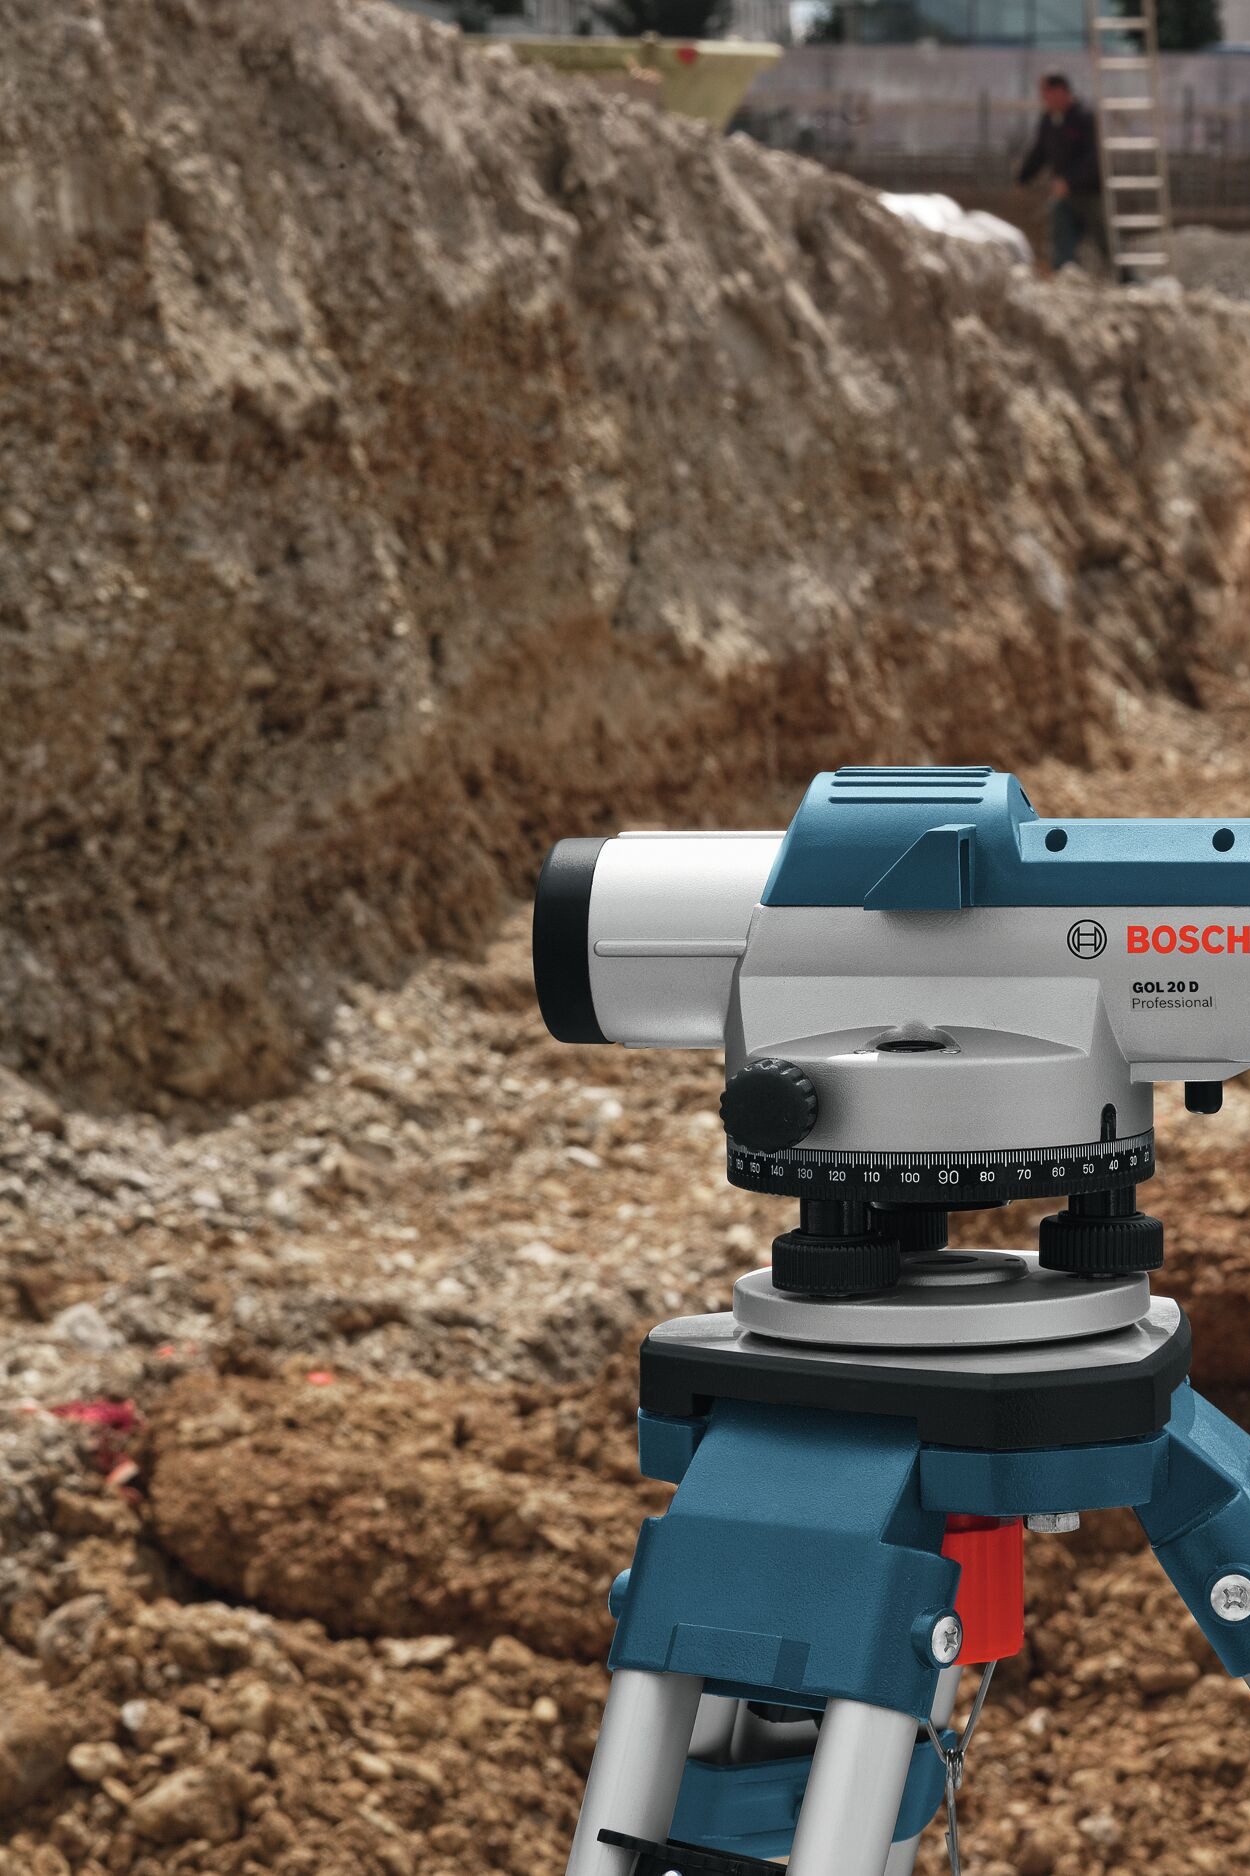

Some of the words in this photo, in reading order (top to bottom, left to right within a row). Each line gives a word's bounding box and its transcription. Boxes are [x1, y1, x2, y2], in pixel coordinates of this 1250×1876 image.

[1127, 925, 1250, 954] BOSCH
[1132, 981, 1164, 993] GOL
[1167, 981, 1186, 993] 20
[1189, 981, 1199, 993] D
[1132, 996, 1213, 1009] Professional
[750, 1162, 761, 1174] 150
[771, 1165, 784, 1177] 140
[797, 1168, 813, 1180] 130
[828, 1170, 846, 1182] 120
[863, 1171, 880, 1182] 110
[900, 1172, 920, 1183] 100
[938, 1170, 959, 1184] 90
[979, 1171, 995, 1182] 80
[1017, 1168, 1032, 1180] 70
[1051, 1166, 1066, 1178] 60
[1083, 1163, 1095, 1175] 50
[1109, 1159, 1119, 1170] 40
[1129, 1155, 1138, 1167] 30
